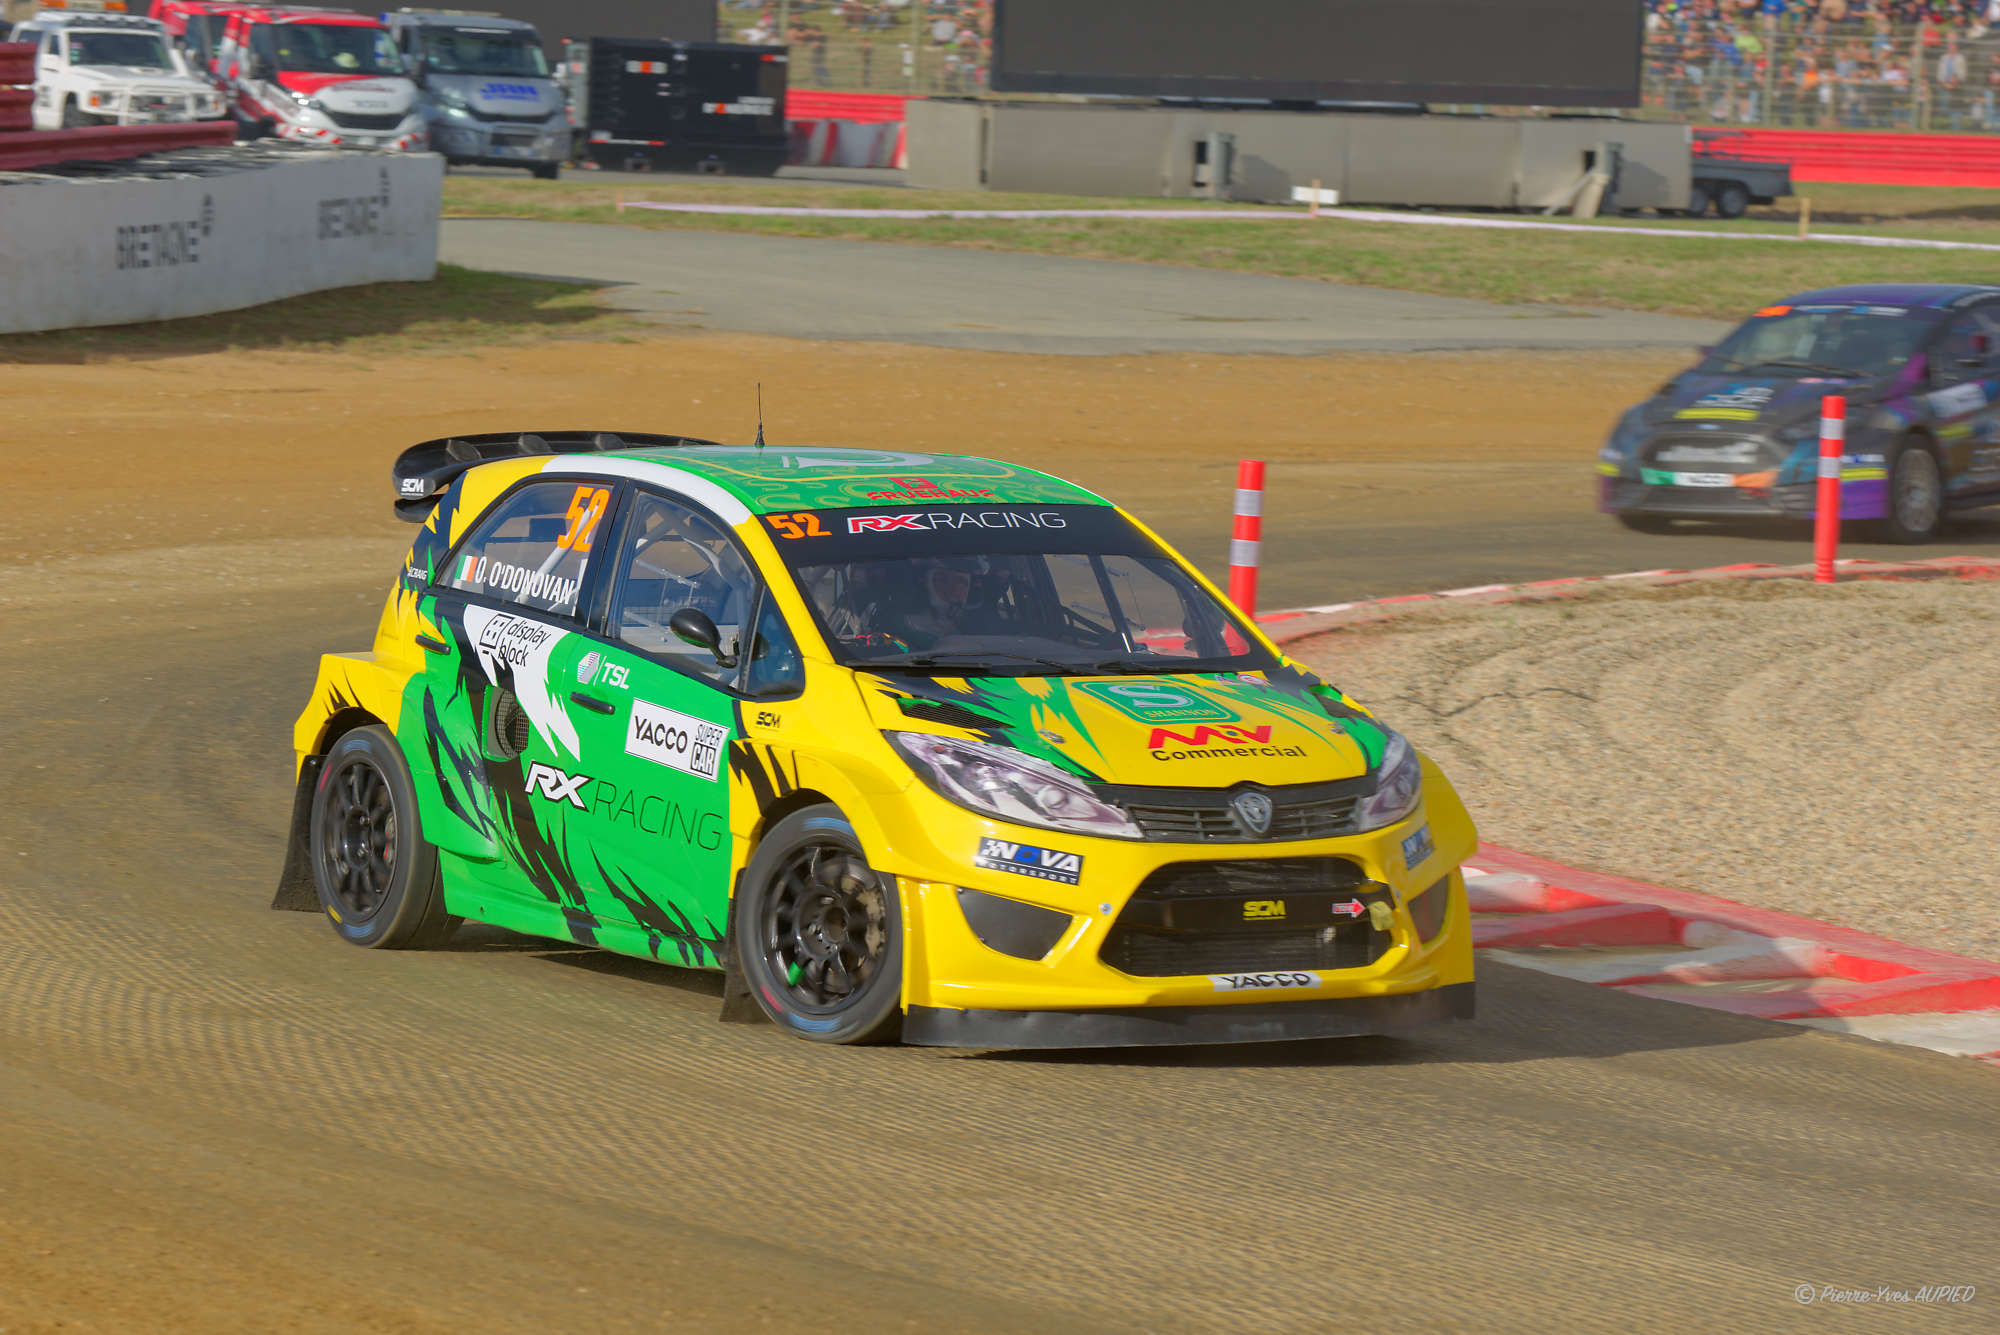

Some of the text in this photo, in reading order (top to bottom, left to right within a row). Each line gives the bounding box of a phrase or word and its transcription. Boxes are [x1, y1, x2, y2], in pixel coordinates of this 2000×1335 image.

[401, 478, 424, 493] SCM
[866, 488, 994, 501] FRUEHAUF
[556, 485, 611, 553] 52
[766, 513, 832, 540] 52
[488, 561, 575, 604] O'DONOVAN
[508, 620, 551, 651] display
[498, 638, 529, 667] block
[601, 662, 630, 690] TSL
[635, 715, 688, 754] YACCO
[695, 723, 723, 747] SUPER
[692, 743, 716, 775] CAR
[1152, 745, 1307, 761] Commercial
[1243, 900, 1286, 917] SCM
[1219, 973, 1311, 989] YACCO
